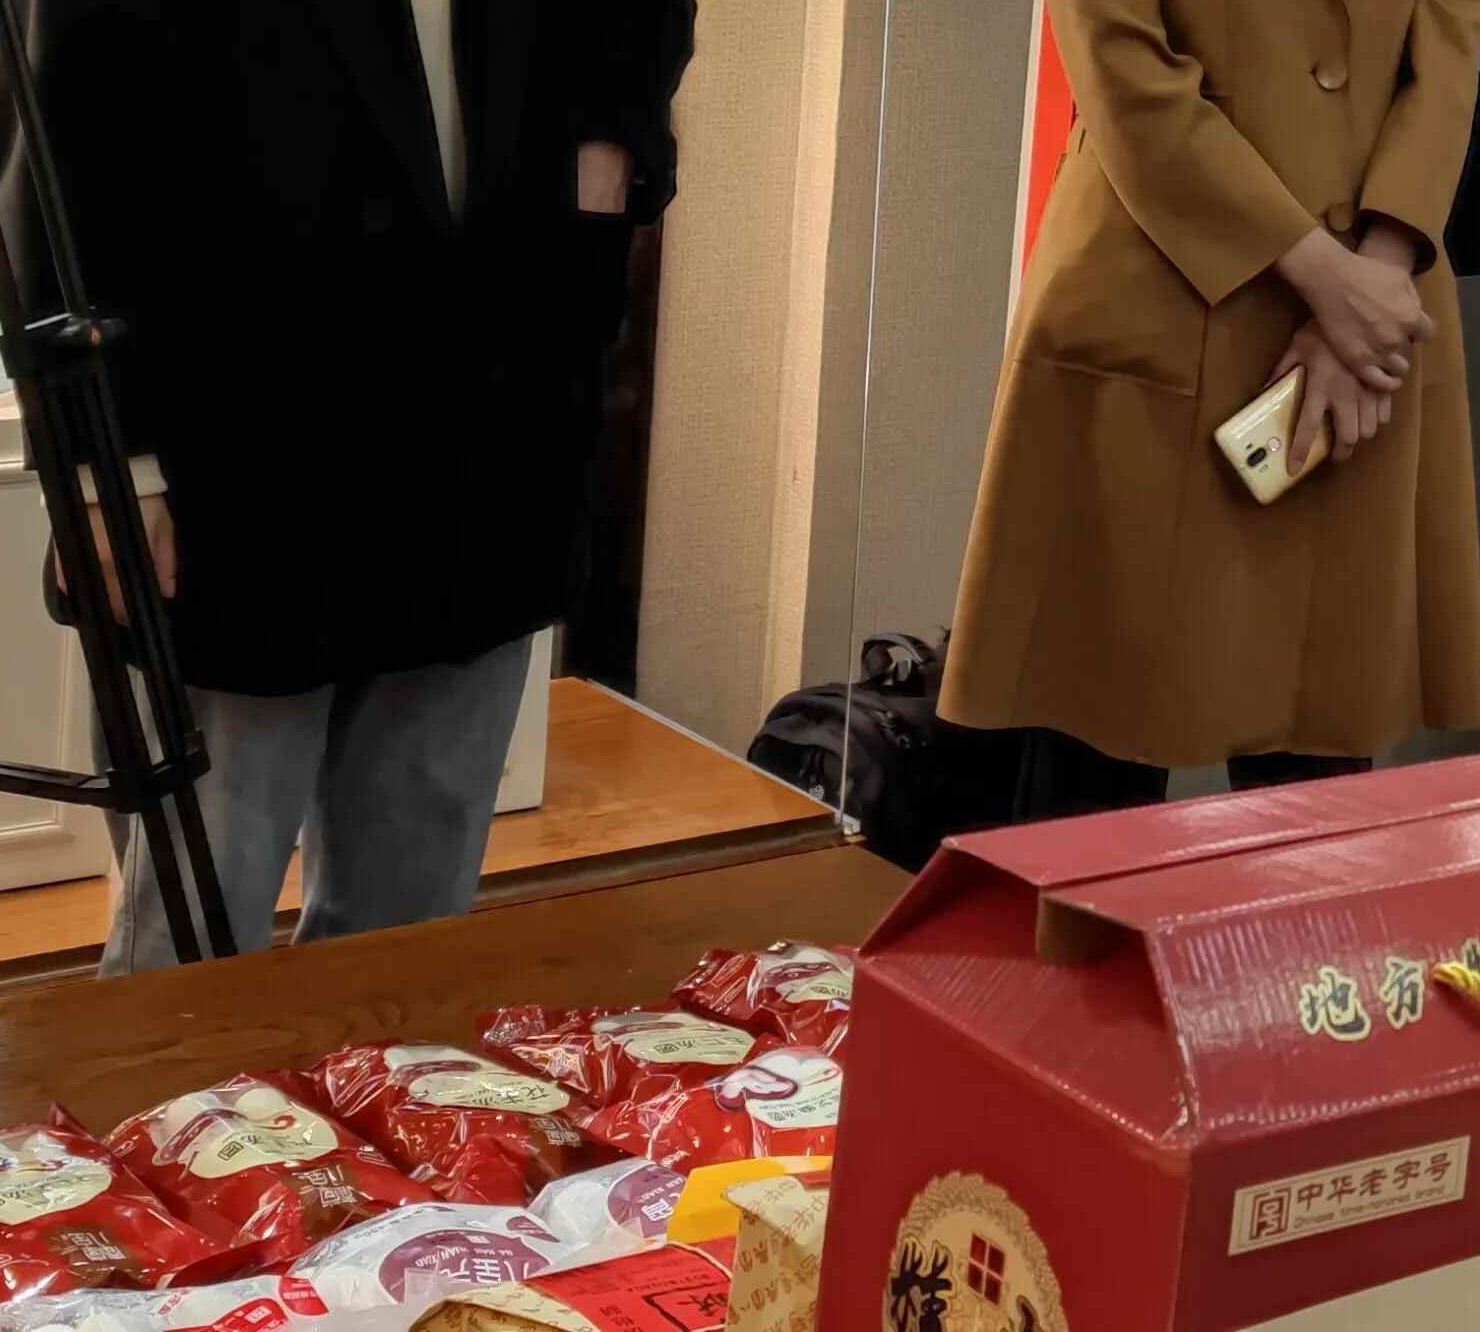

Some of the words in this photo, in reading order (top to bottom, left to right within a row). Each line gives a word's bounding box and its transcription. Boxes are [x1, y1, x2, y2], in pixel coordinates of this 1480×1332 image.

[1296, 1151, 1452, 1213] 中华老字号
